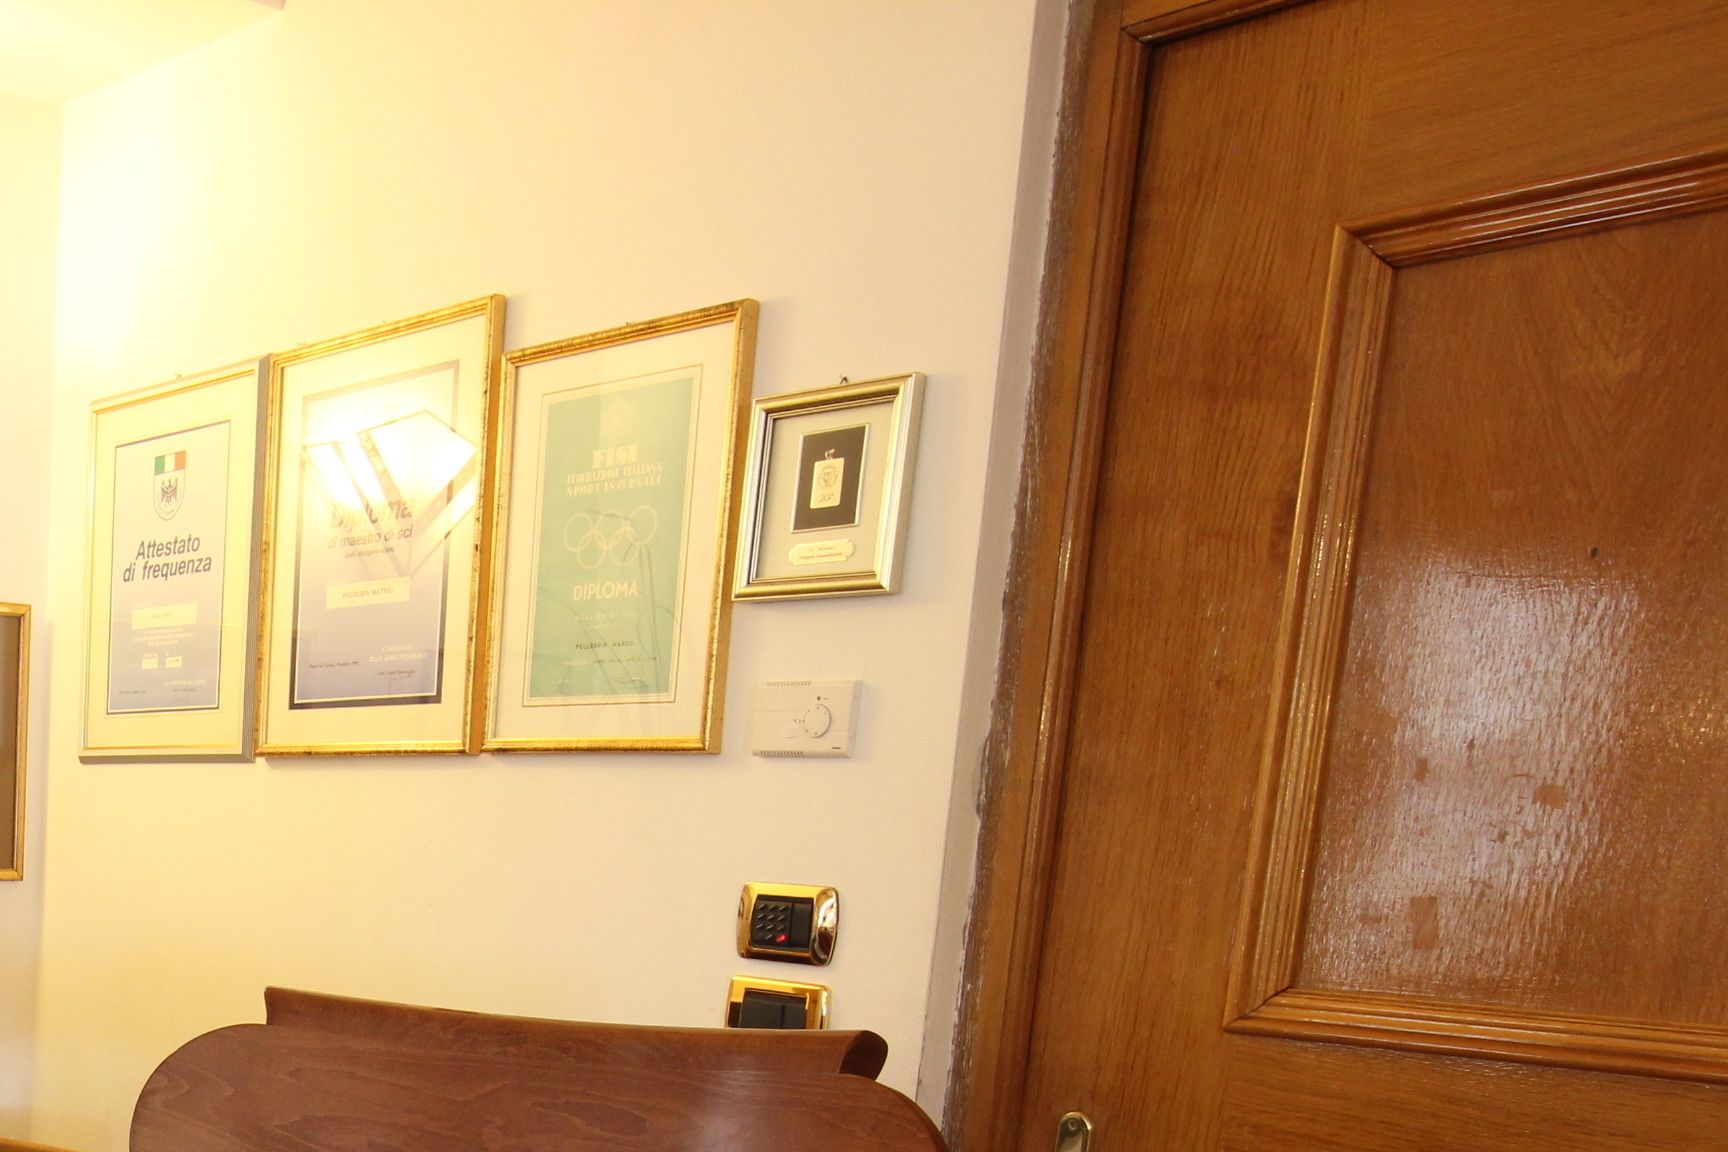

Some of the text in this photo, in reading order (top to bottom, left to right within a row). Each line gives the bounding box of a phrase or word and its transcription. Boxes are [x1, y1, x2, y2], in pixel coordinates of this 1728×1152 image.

[135, 533, 201, 560] Attestato
[340, 531, 381, 547] maestro
[397, 524, 414, 540] sci
[123, 556, 212, 582] di frequenza
[573, 580, 640, 601] DIPLOMA
